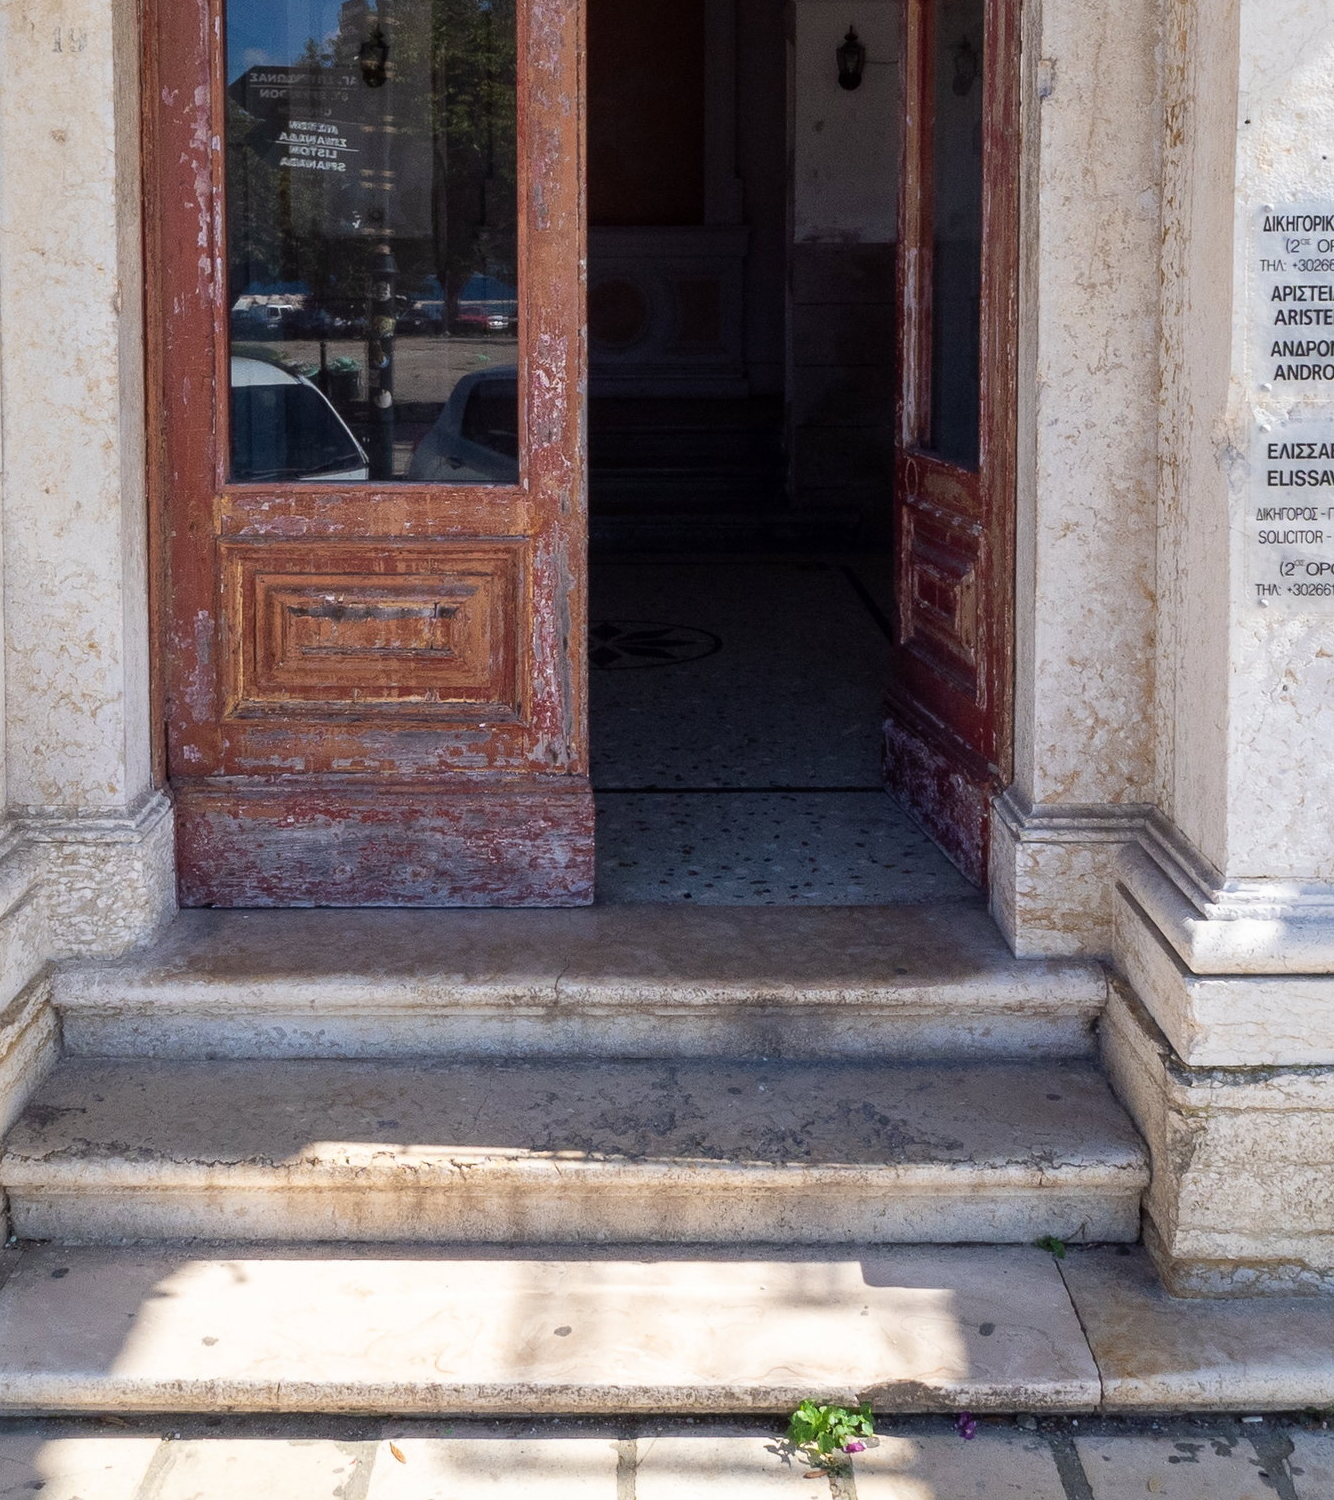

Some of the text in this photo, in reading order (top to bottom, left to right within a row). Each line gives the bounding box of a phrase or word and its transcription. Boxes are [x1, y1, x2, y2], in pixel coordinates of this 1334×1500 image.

[1260, 259, 1287, 272] ΤΗΛ:
[1256, 507, 1319, 521] ΔΙΚΗΓΟΡΟΣ
[1258, 530, 1324, 544] SOLICITOR
[1255, 584, 1282, 596] ΤΗΛ:
